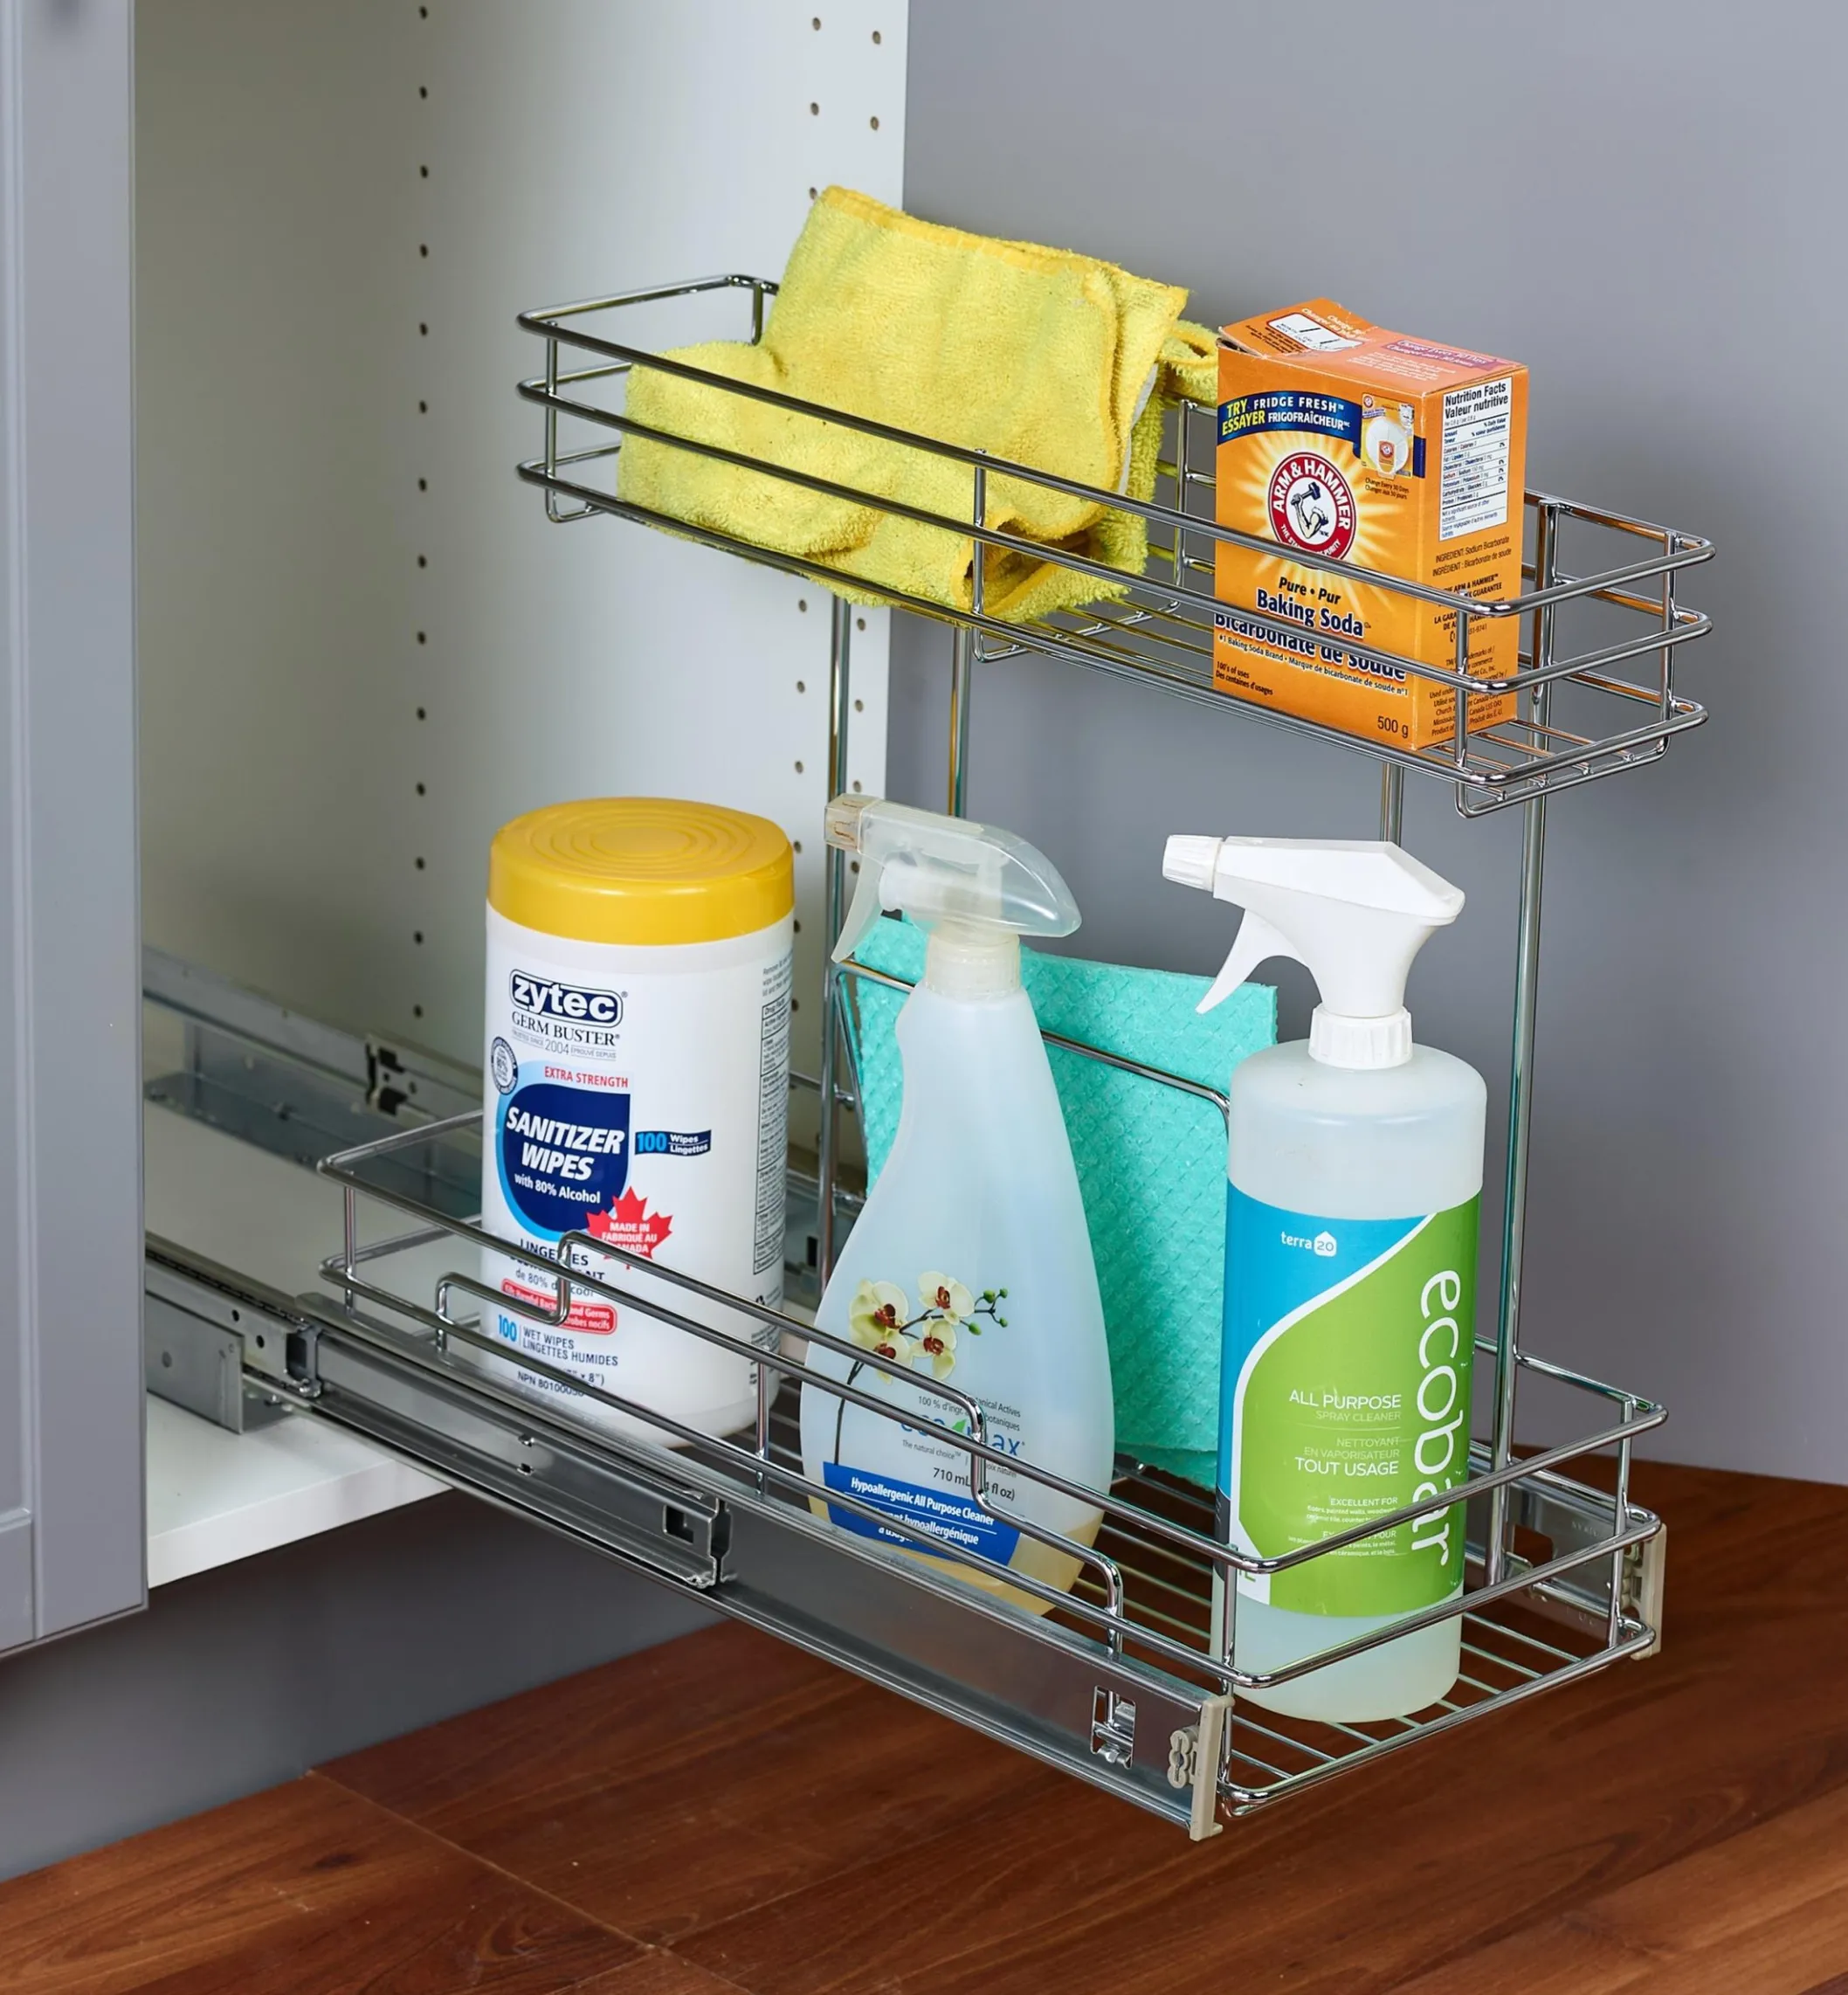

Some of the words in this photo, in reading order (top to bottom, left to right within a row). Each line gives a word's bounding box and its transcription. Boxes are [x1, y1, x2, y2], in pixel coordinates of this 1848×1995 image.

[1445, 389, 1482, 407] Nutrition
[1484, 382, 1507, 397] Facts
[1226, 398, 1248, 418] TRY
[1254, 397, 1293, 410] FRIDGE
[1445, 404, 1472, 419] Valeur
[1473, 395, 1508, 412] nutritive
[1222, 411, 1265, 436] ESSAYER
[1272, 469, 1293, 514] ARM
[1290, 462, 1303, 479] &
[1304, 459, 1351, 530] HAMMER
[1280, 524, 1290, 540] THE
[1465, 544, 1483, 555] Sodium
[1483, 536, 1510, 550] Bicarbonate
[1499, 548, 1512, 558] soude
[1279, 576, 1307, 596] Pure
[1318, 588, 1341, 604] Pur
[1472, 583, 1502, 597] GUARANTEE
[1257, 589, 1315, 627] Baking
[1320, 608, 1363, 637] Soda
[1444, 621, 1450, 630] DE
[1228, 638, 1248, 651] Baking
[1249, 644, 1265, 655] Soda
[1265, 648, 1284, 661] Brand
[1288, 657, 1313, 673] Marque
[1314, 664, 1323, 673] de
[1324, 666, 1362, 684] bicarbonate
[1364, 678, 1373, 687] de
[1374, 680, 1396, 693] soude
[1237, 670, 1250, 679] uses
[1216, 670, 1224, 680] Des
[1225, 673, 1250, 688] centaines
[1250, 681, 1273, 695] d'usages
[1377, 715, 1398, 733] 500
[1402, 723, 1409, 738] g
[514, 976, 617, 1021] zytec
[512, 1011, 549, 1037] GERM
[544, 1039, 569, 1055] 2004
[544, 1066, 573, 1082] EXTRA
[576, 1073, 629, 1088] STRENGTH
[506, 1106, 625, 1155] SANITIZER
[637, 1132, 667, 1153] 100
[670, 1133, 699, 1145] Wipes
[670, 1143, 708, 1156] Lingettes
[521, 1142, 595, 1181] WIPES
[514, 1172, 534, 1191] with
[535, 1180, 557, 1197] 80%
[558, 1184, 601, 1205] Alcohol
[610, 1223, 638, 1232] MADE
[639, 1223, 650, 1232] IN
[645, 1233, 658, 1243] AU
[1281, 1231, 1313, 1250] terra
[1317, 1240, 1334, 1252] 20
[515, 1268, 526, 1279] de
[528, 1273, 548, 1288] 80%
[584, 1307, 610, 1319] Germs
[499, 1315, 517, 1343] 100
[523, 1326, 541, 1342] WET
[544, 1333, 575, 1350] WIPES
[523, 1337, 568, 1360] LINGETTES
[571, 1351, 618, 1366] HUMIDES
[517, 1370, 535, 1384] NPN
[919, 1396, 932, 1407] 100
[933, 1399, 941, 1409] %
[1289, 1389, 1319, 1407] ALL
[1322, 1394, 1402, 1410] PURPOSE
[998, 1403, 1021, 1418] Actives
[1316, 1411, 1351, 1422] SPRAY
[1353, 1412, 1402, 1422] CLEANER
[1411, 1270, 1464, 1566] ecobar
[903, 1439, 914, 1448] The
[914, 1442, 935, 1456] natural
[1336, 1437, 1399, 1447] NETTOYANT
[1304, 1446, 1319, 1457] EN
[1320, 1449, 1400, 1460] VAPORISATEUR
[1294, 1456, 1341, 1475] TOUT
[1345, 1460, 1399, 1476] USAGE
[933, 1467, 953, 1482] 710
[955, 1473, 971, 1487] mL
[991, 1482, 998, 1495] fl
[1000, 1488, 1015, 1501] oz)
[852, 1477, 913, 1504] Hypoallergenic
[914, 1493, 926, 1506] All
[927, 1496, 962, 1516] Purpose
[962, 1507, 995, 1527] Cleaner
[1330, 1498, 1380, 1507] EXCELLENT
[904, 1513, 979, 1545] hypoallergénique
[1373, 1530, 1396, 1540] POUR
